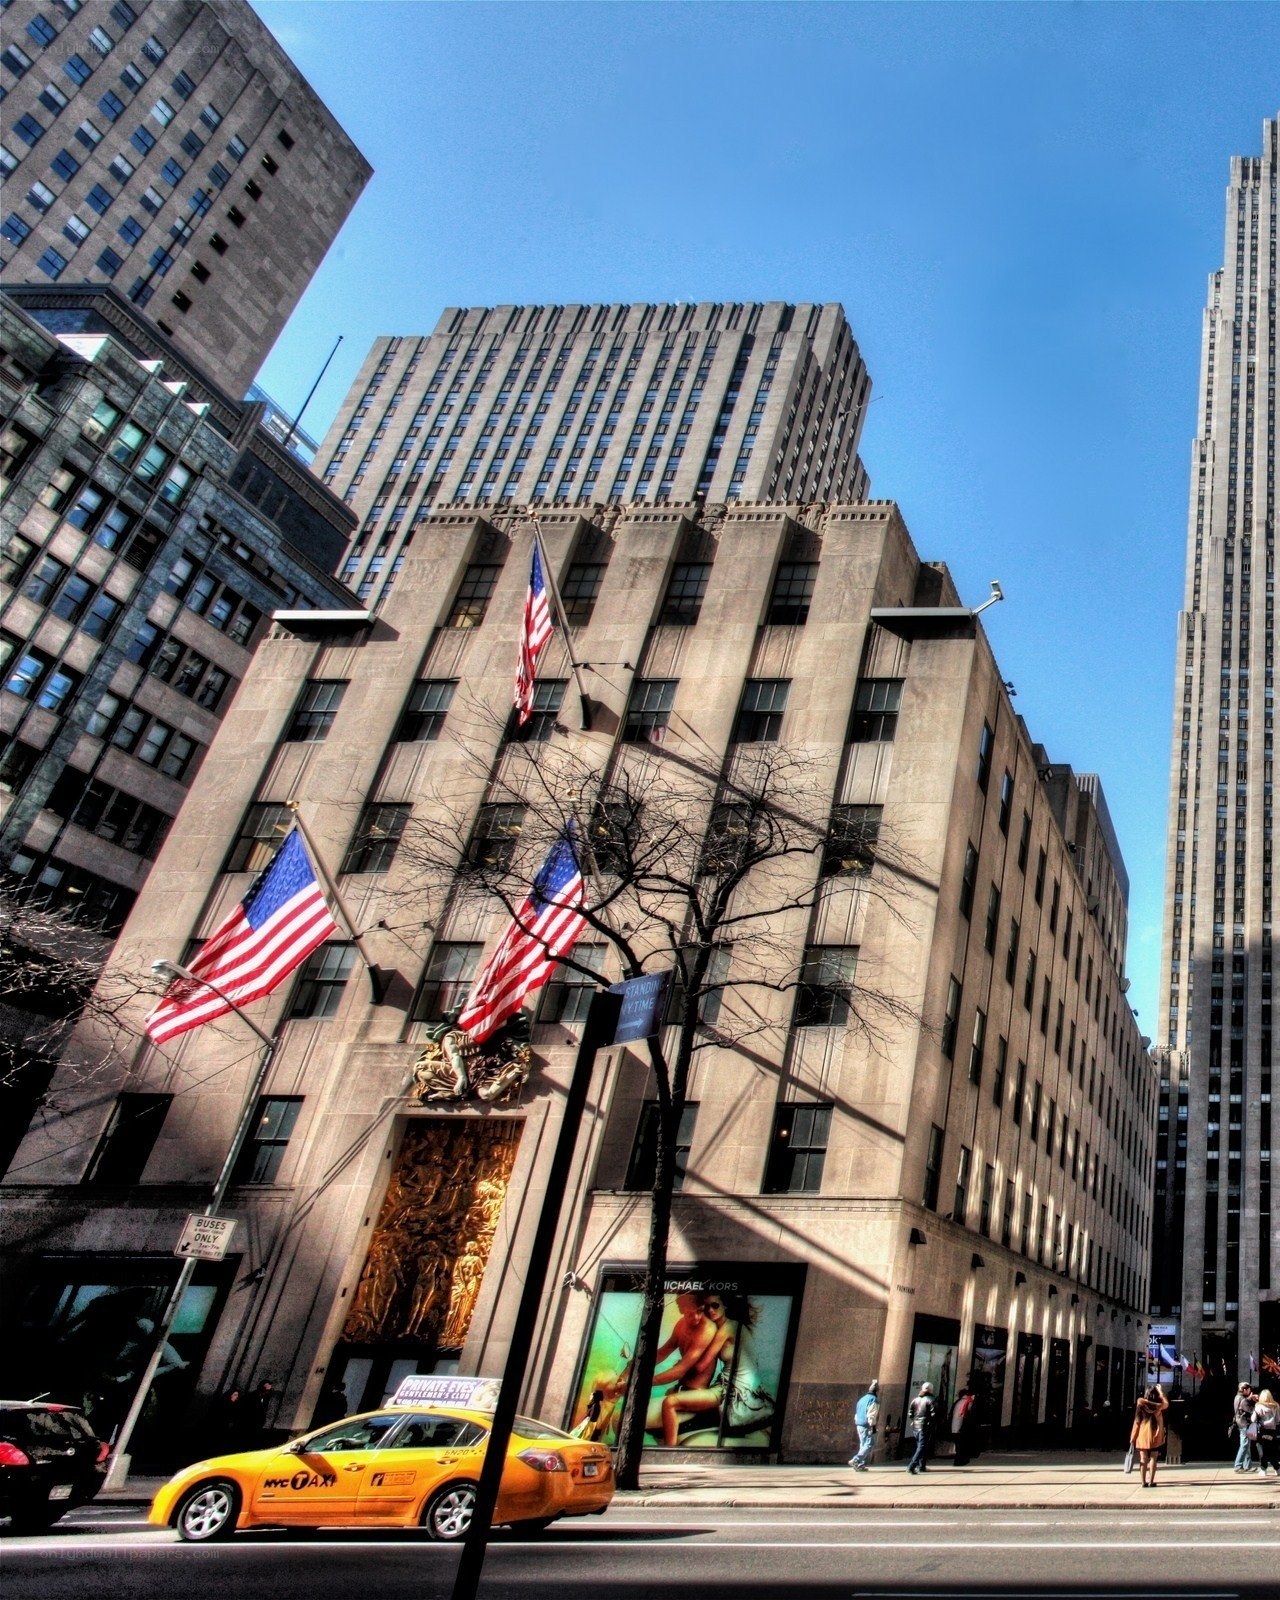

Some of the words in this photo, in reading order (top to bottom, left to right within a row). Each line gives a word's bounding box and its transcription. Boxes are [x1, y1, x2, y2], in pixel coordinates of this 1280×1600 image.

[196, 1218, 227, 1230] BUSES
[194, 1233, 218, 1243] ONLY
[709, 1282, 738, 1290] KORS
[401, 1379, 447, 1391] PRIVATE
[448, 1380, 477, 1392] EYES
[400, 1389, 450, 1399] GENTLEMEN'S
[451, 1392, 471, 1400] CLUB
[264, 1478, 289, 1488] NYC
